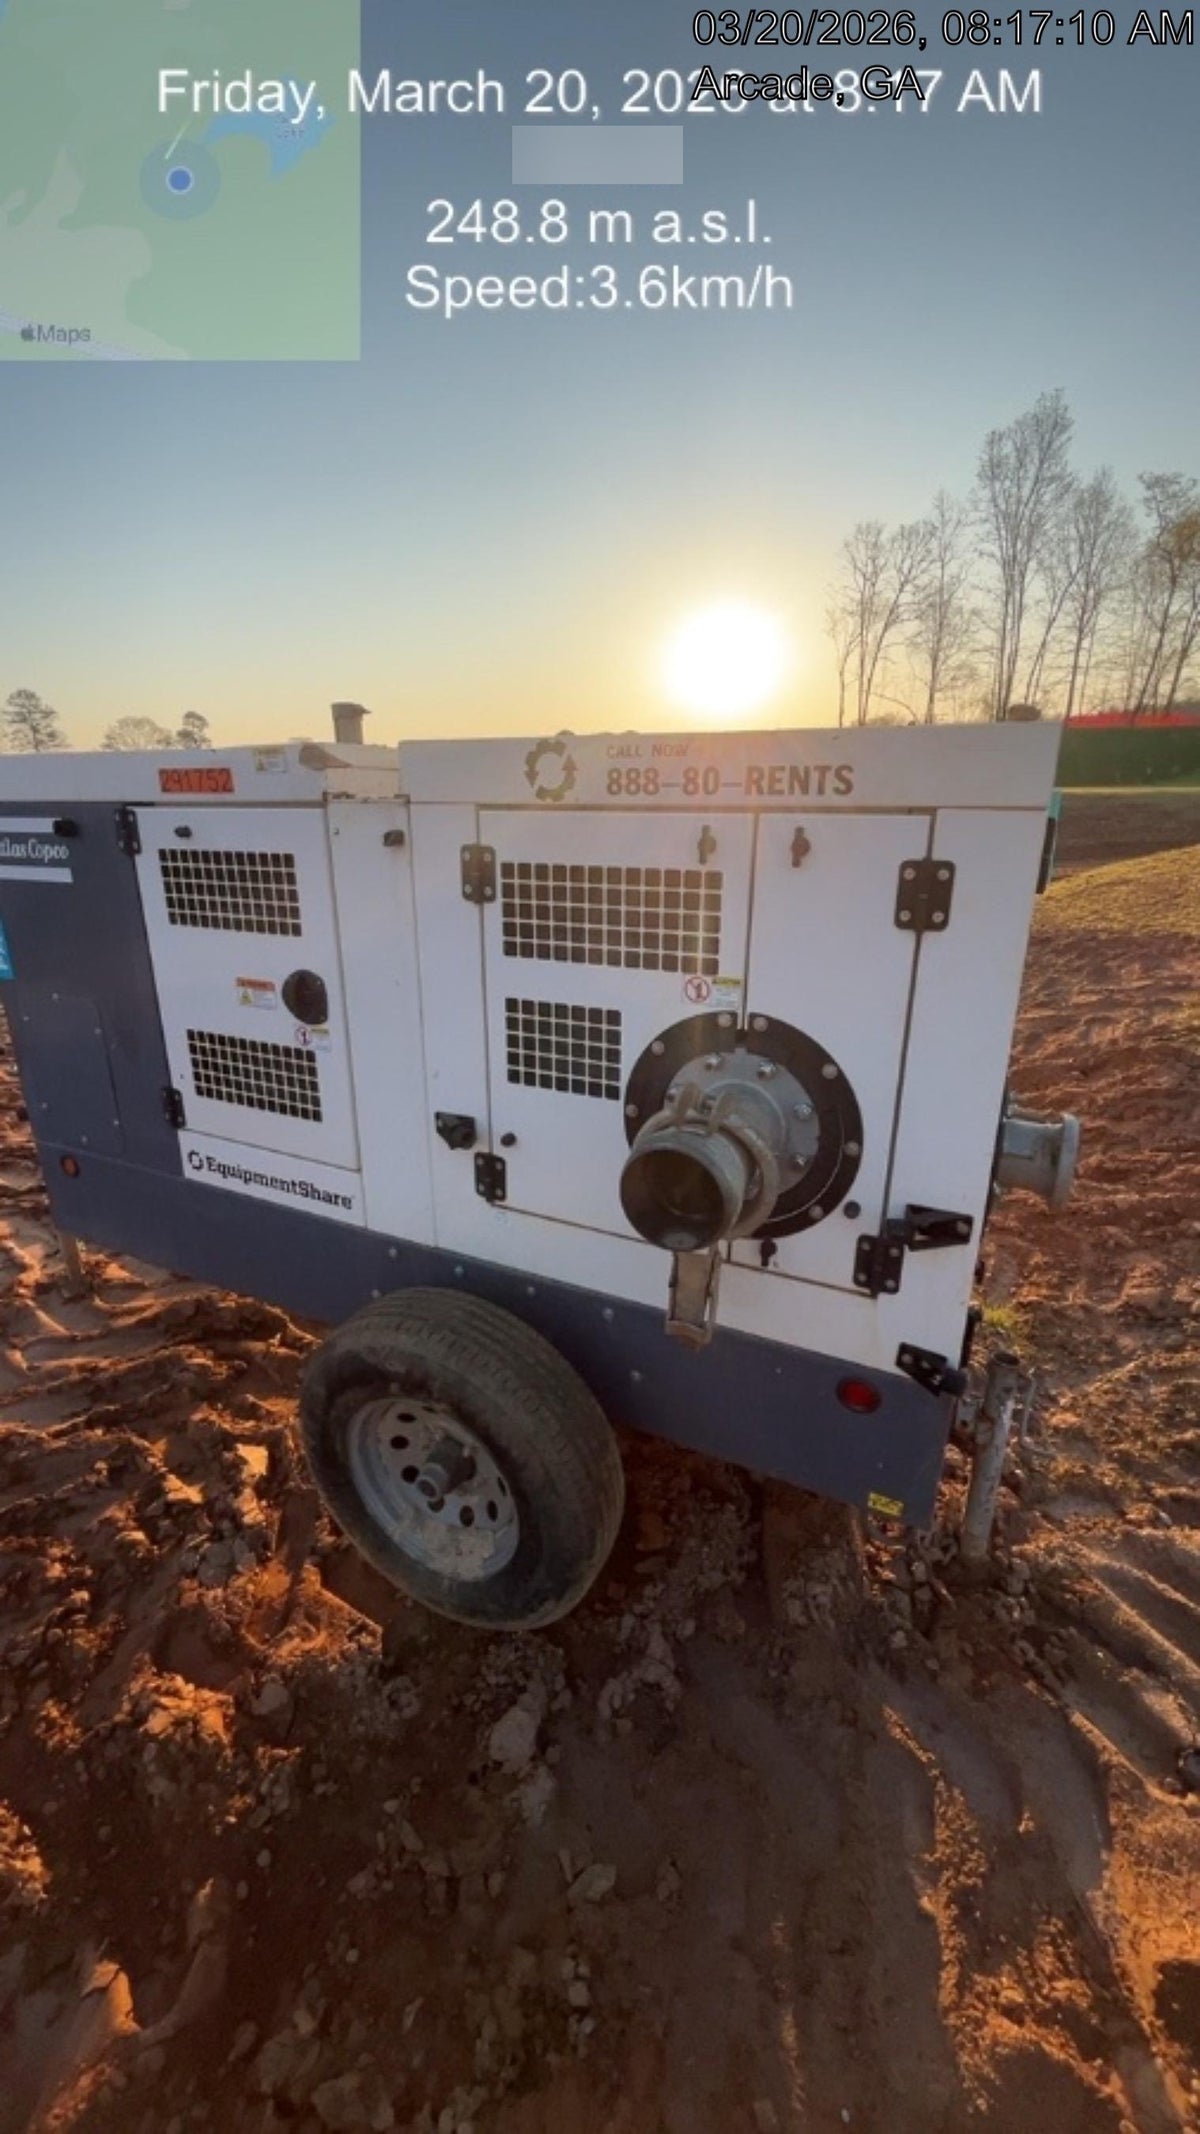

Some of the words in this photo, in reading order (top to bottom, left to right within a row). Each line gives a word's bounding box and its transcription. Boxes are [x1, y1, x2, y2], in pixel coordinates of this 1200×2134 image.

[606, 745, 642, 758] CALL
[652, 744, 689, 757] NOW
[606, 765, 854, 796] 888-80-RENTS
[28, 839, 69, 863] Copco
[206, 1156, 352, 1209] EquipmentShare
